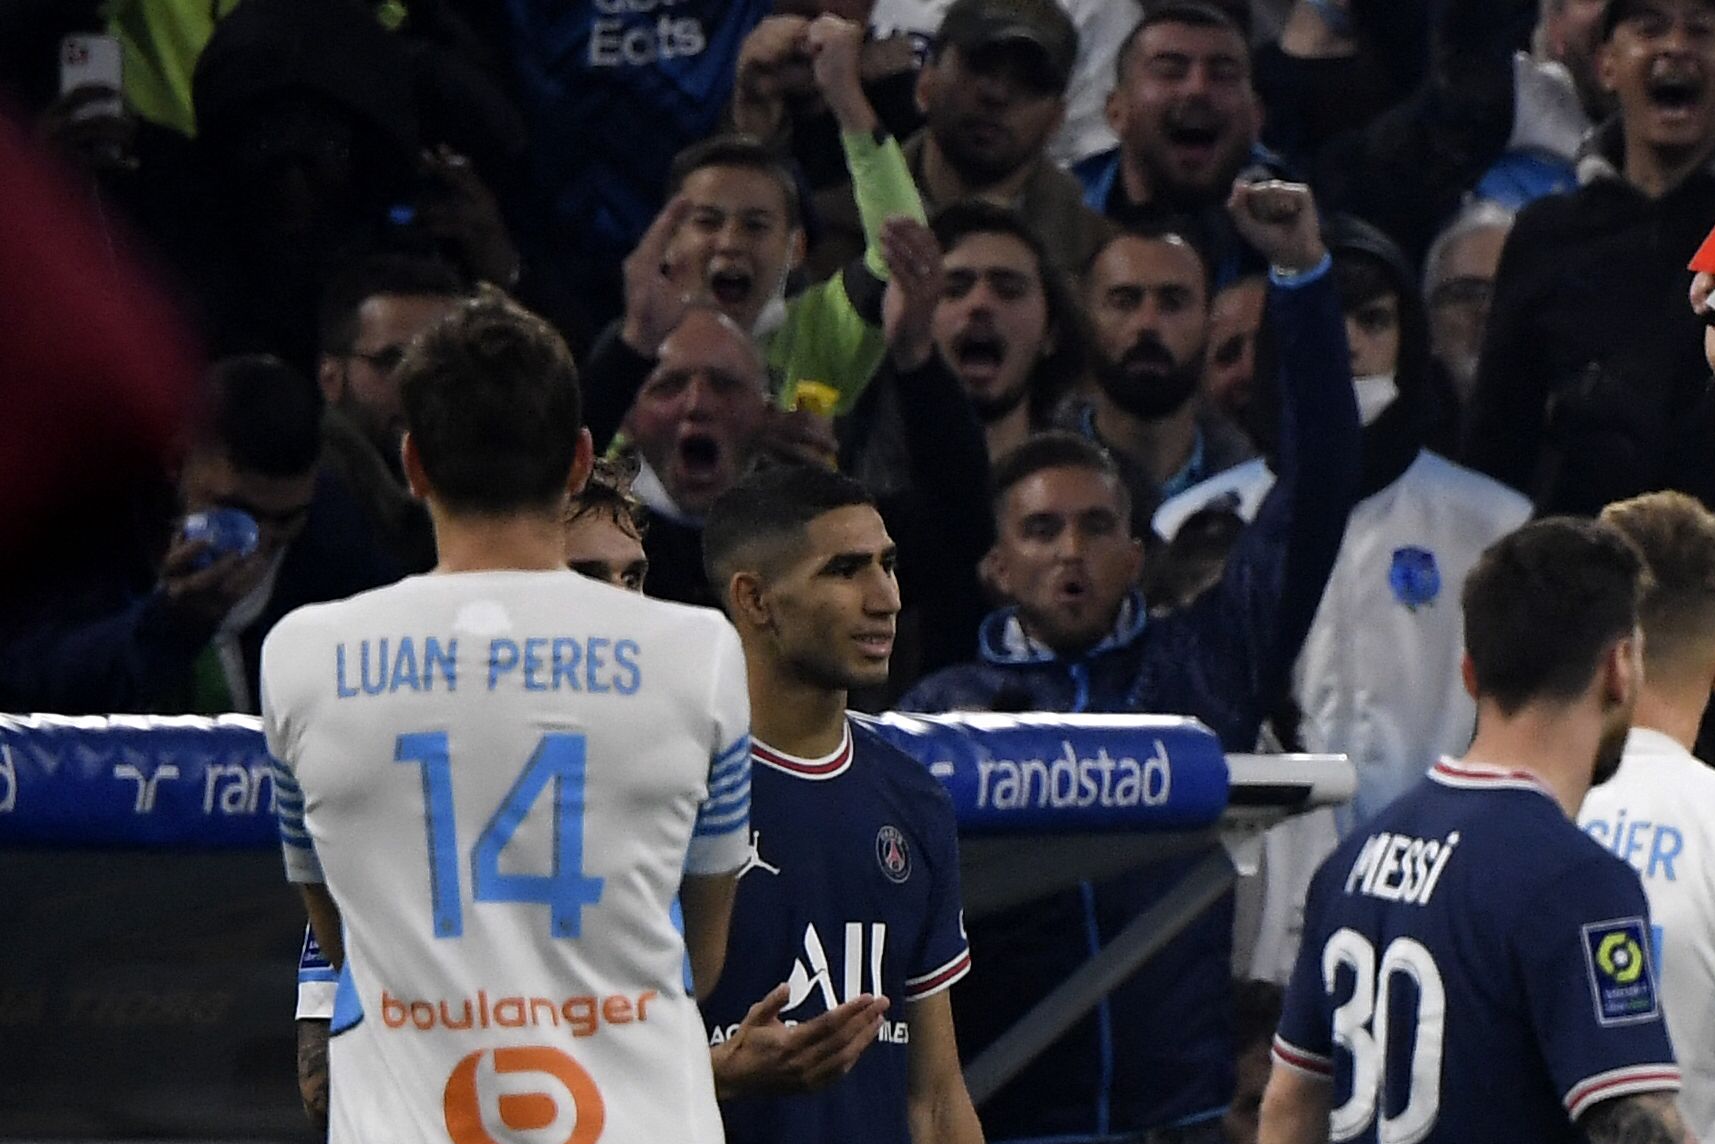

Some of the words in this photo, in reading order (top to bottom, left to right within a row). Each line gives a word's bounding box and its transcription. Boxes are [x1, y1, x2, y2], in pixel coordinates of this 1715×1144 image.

[589, 15, 706, 66] Eats
[336, 636, 457, 698] LUAN
[487, 636, 641, 695] PERES
[977, 739, 1172, 810] randstad
[393, 730, 605, 939] 14
[380, 989, 657, 1038] boulanger
